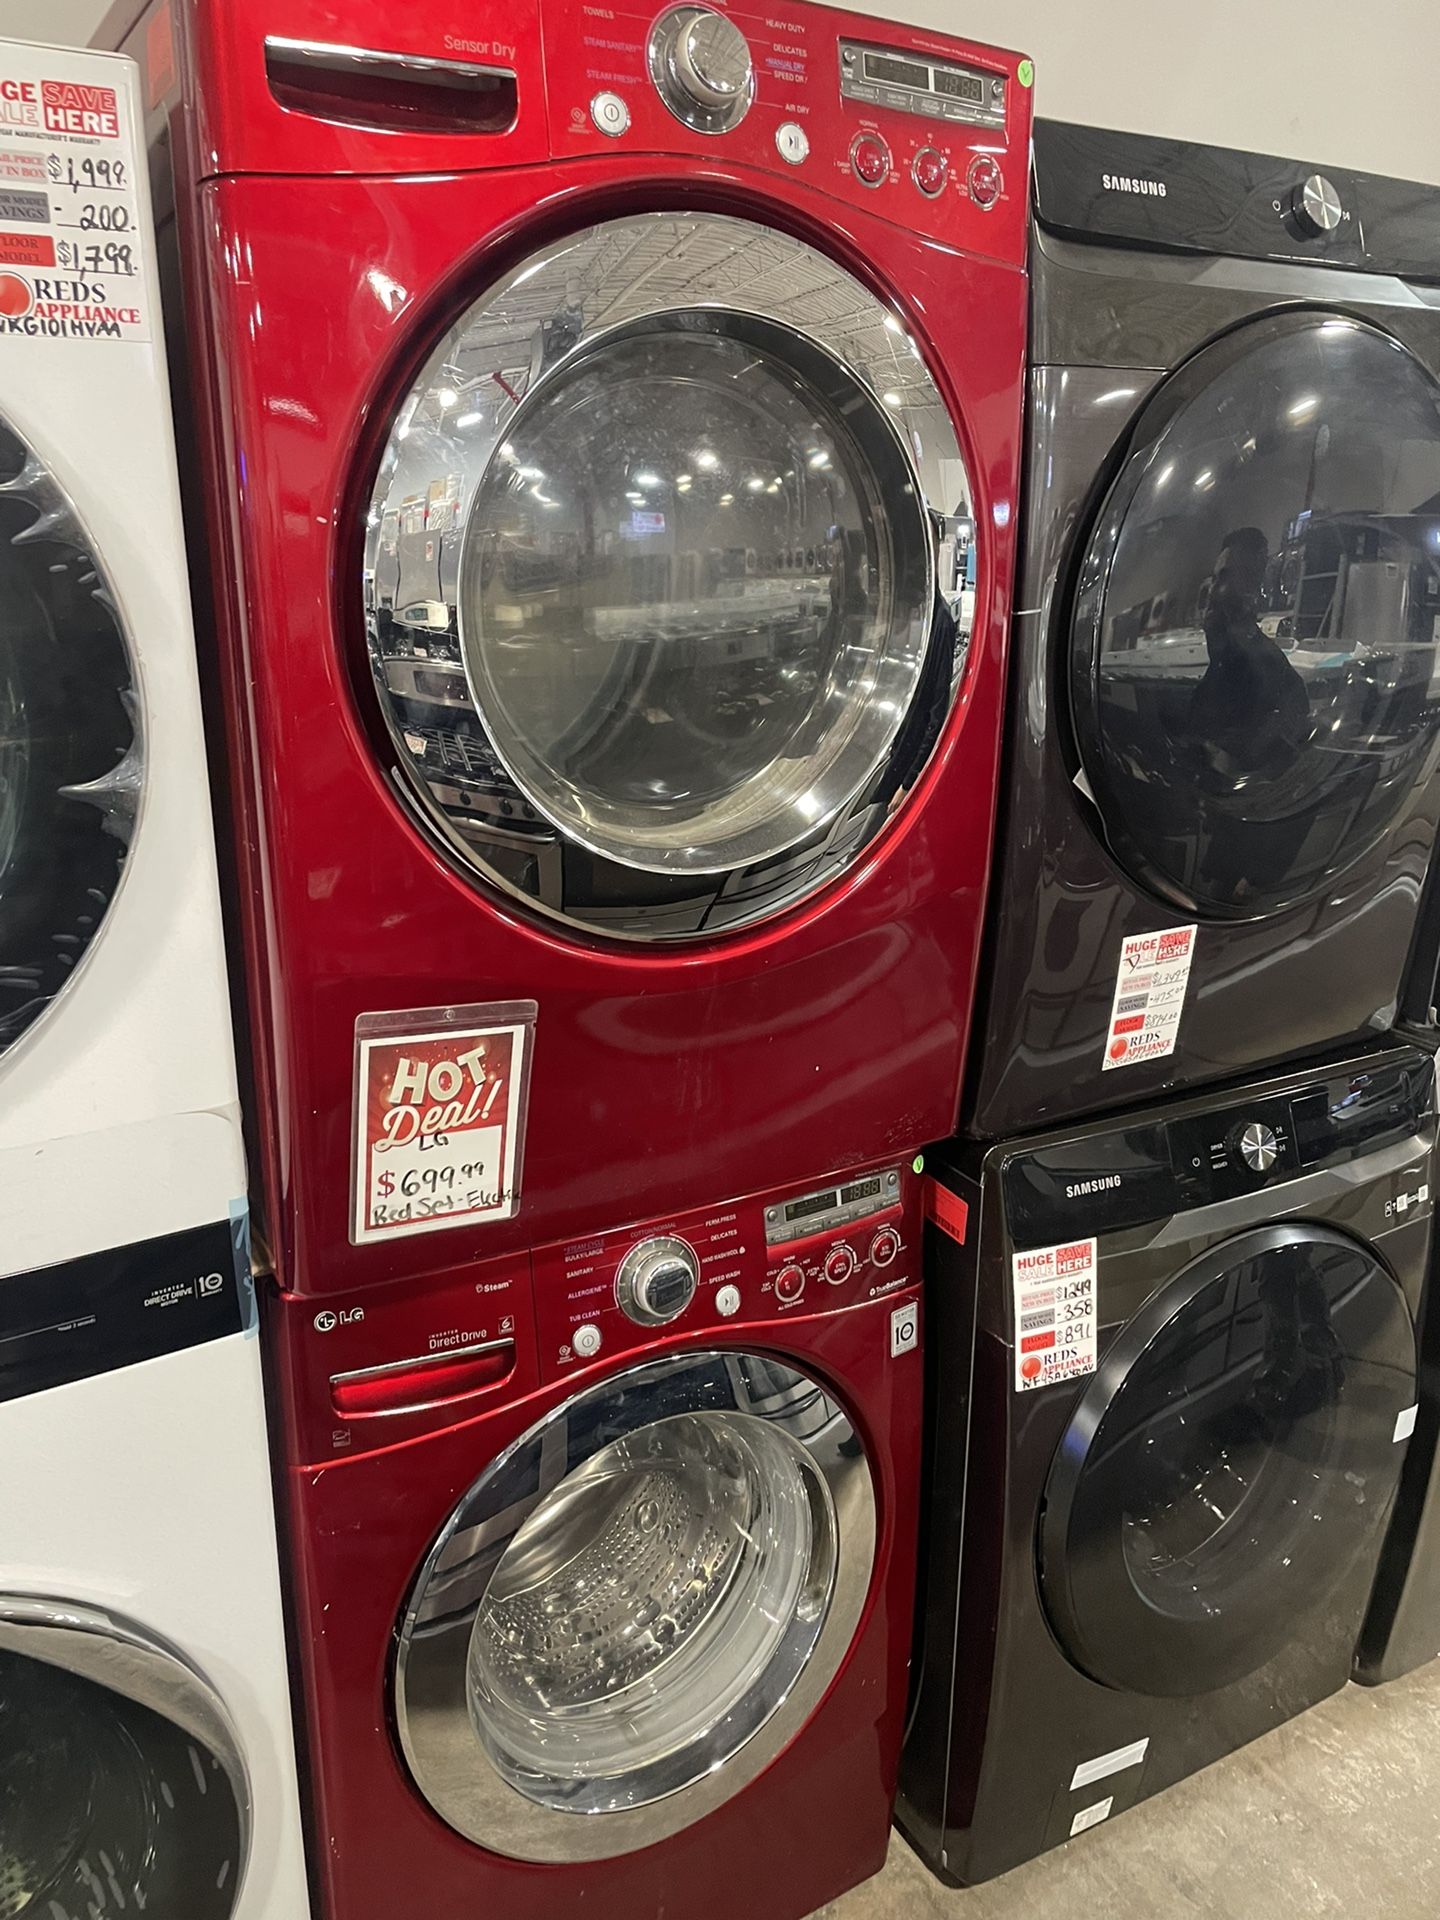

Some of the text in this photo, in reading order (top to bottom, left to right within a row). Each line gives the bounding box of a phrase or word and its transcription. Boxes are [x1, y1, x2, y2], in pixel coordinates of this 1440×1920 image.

[583, 6, 615, 19] TOWELS
[765, 18, 806, 33] HEAVY DUTY
[443, 34, 516, 60] Sensor Dry
[583, 36, 606, 49] STEAM
[773, 43, 808, 57] DELICATES
[586, 69, 612, 81] STEAM
[773, 70, 794, 82] SPEED
[42, 83, 116, 113] SAVE
[785, 103, 810, 115] AIR DRY
[46, 106, 117, 136] HERE
[14, 154, 44, 165] PRICE
[22, 167, 47, 179] BOX
[1102, 174, 1167, 197] SAMSUNG
[33, 279, 106, 303] REDS
[33, 302, 141, 324] APPLIANCE
[1125, 938, 1158, 954] HUGE
[1127, 1039, 1172, 1057] APPLIANCE
[1130, 1031, 1161, 1047] REDS
[389, 1047, 488, 1105] HOT
[374, 1079, 503, 1153] Deal!
[419, 1131, 450, 1151] LG
[377, 1161, 485, 1198] $699.99
[1066, 1175, 1122, 1198] SAMSUNG
[372, 1202, 413, 1226] Red
[710, 1229, 738, 1242] DELICATES
[565, 1248, 605, 1263] BULKY/LARGE
[1017, 1244, 1091, 1270] HUGE SAVE
[566, 1267, 594, 1279] SANITARY
[709, 1269, 742, 1285] SPEED WASH
[1018, 1264, 1055, 1281] SALE
[1057, 1257, 1091, 1274] HERE
[151, 1283, 185, 1296] INVERTER
[198, 1273, 223, 1292] 10
[144, 1287, 193, 1307] DIRECT DRIVE
[339, 1307, 365, 1325] LG
[569, 1310, 601, 1323] TUB CLEAN
[428, 1329, 459, 1338] INVERTER
[429, 1329, 487, 1350] Direct Drive
[896, 1321, 915, 1345] 10
[1043, 1355, 1093, 1375] APPLIANCE
[1044, 1347, 1078, 1365] REDS
